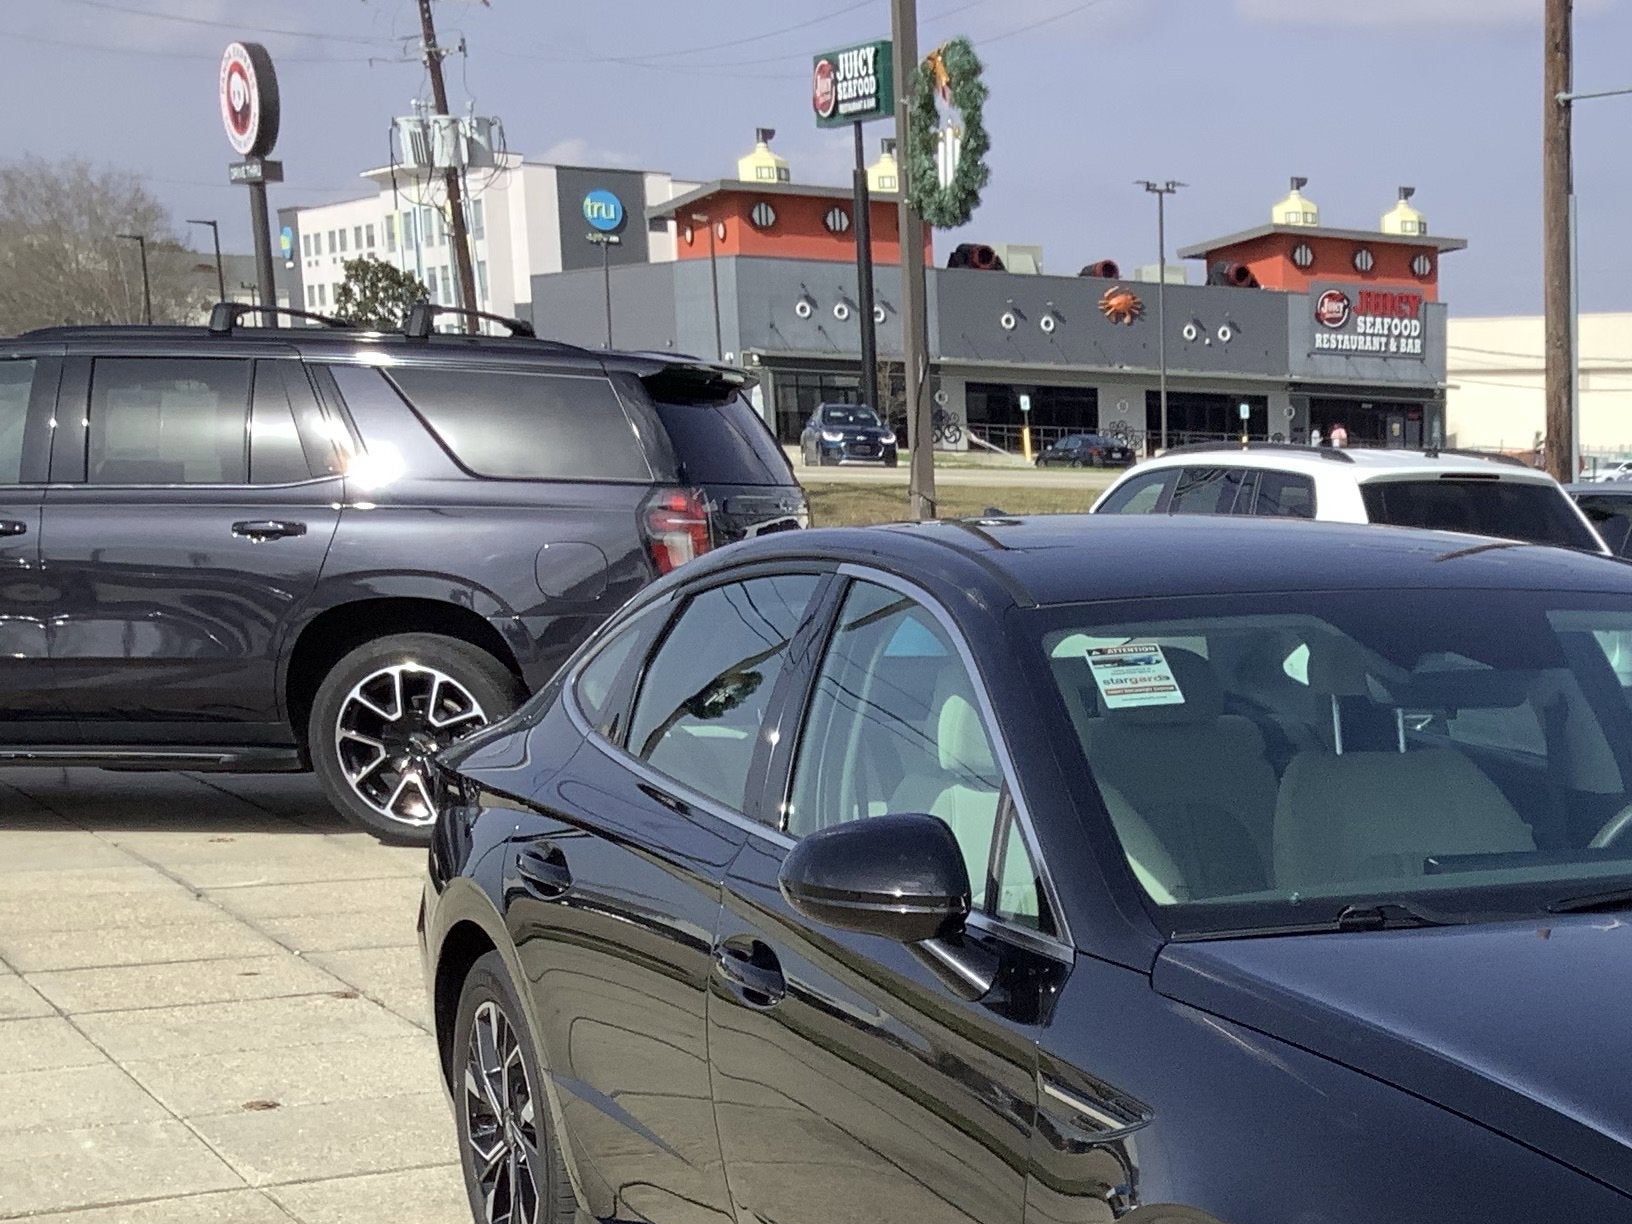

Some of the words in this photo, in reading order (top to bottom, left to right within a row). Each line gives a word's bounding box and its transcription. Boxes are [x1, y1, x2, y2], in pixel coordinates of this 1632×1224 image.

[836, 47, 876, 81] JUICY
[837, 75, 876, 101] SEAFOOD
[584, 198, 616, 219] tru
[1352, 290, 1421, 318] JUICY
[1357, 316, 1420, 337] SEAFOOD
[1315, 333, 1387, 352] RESTAURANT
[1389, 339, 1398, 352] &
[1400, 338, 1421, 353] BAR
[1107, 646, 1156, 655] ATTENTION
